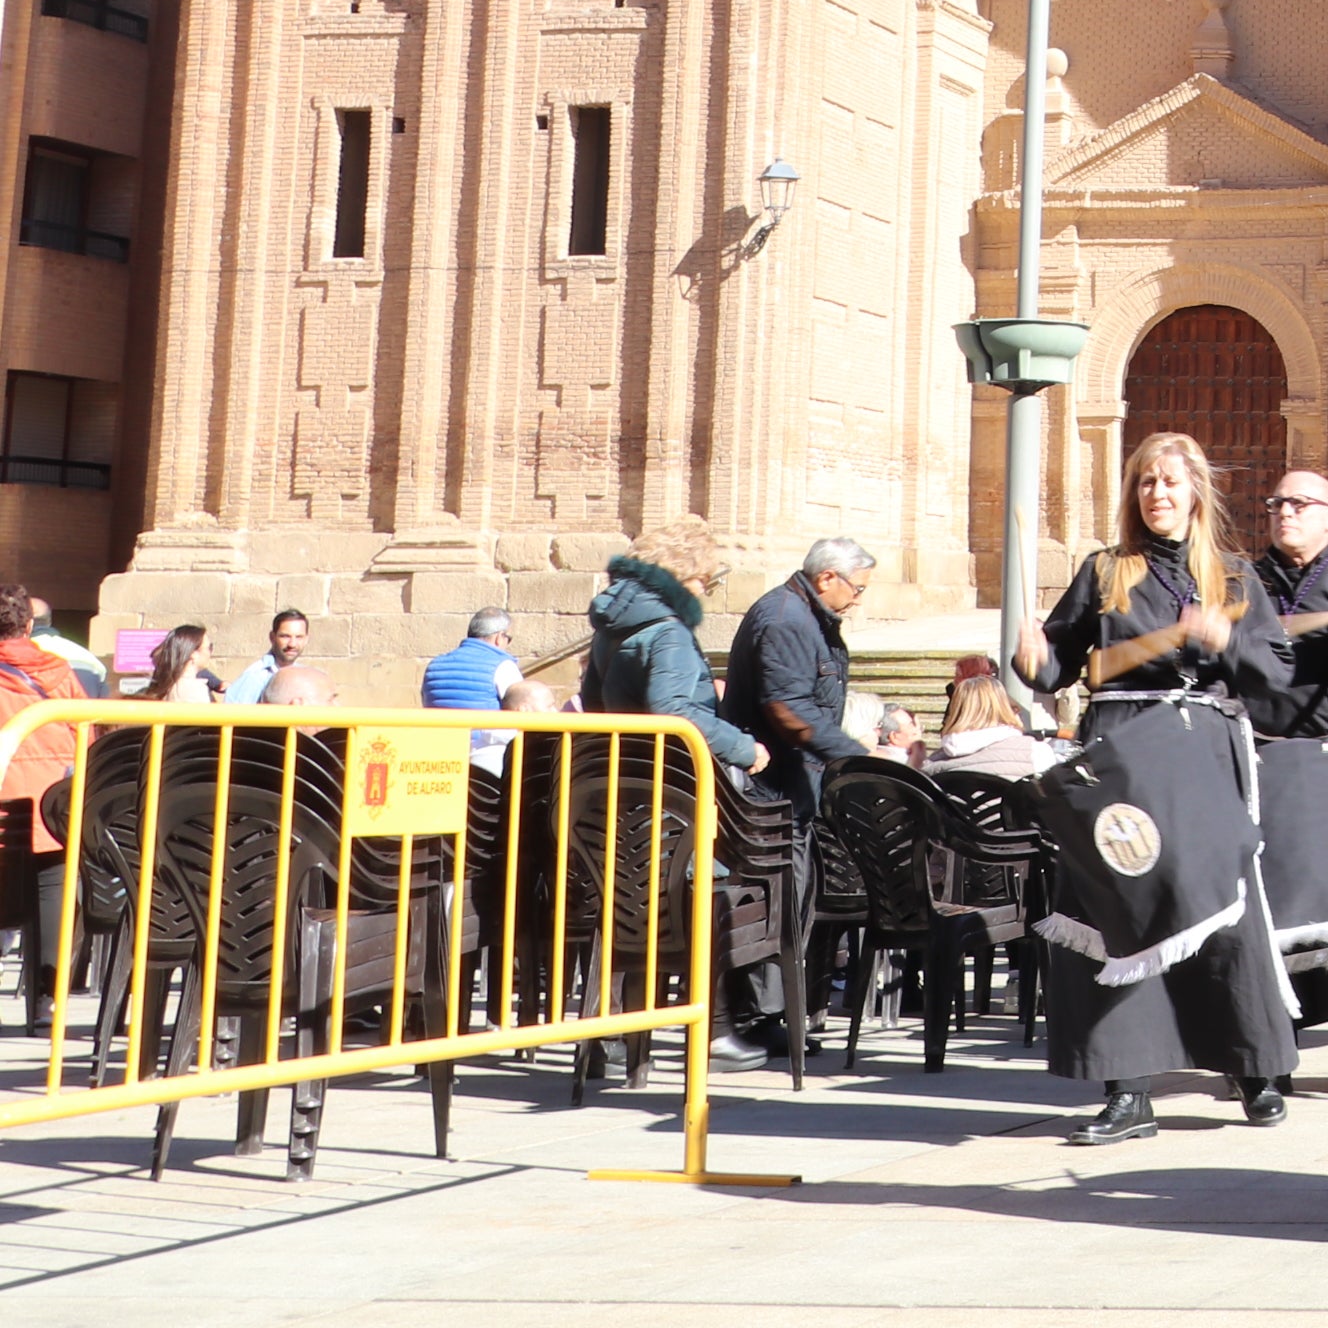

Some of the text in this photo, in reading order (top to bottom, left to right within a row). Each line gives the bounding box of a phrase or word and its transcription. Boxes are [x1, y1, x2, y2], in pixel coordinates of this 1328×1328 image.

[399, 760, 462, 774] AYUNTAMIENTO
[407, 781, 452, 795] DE ALFARO
